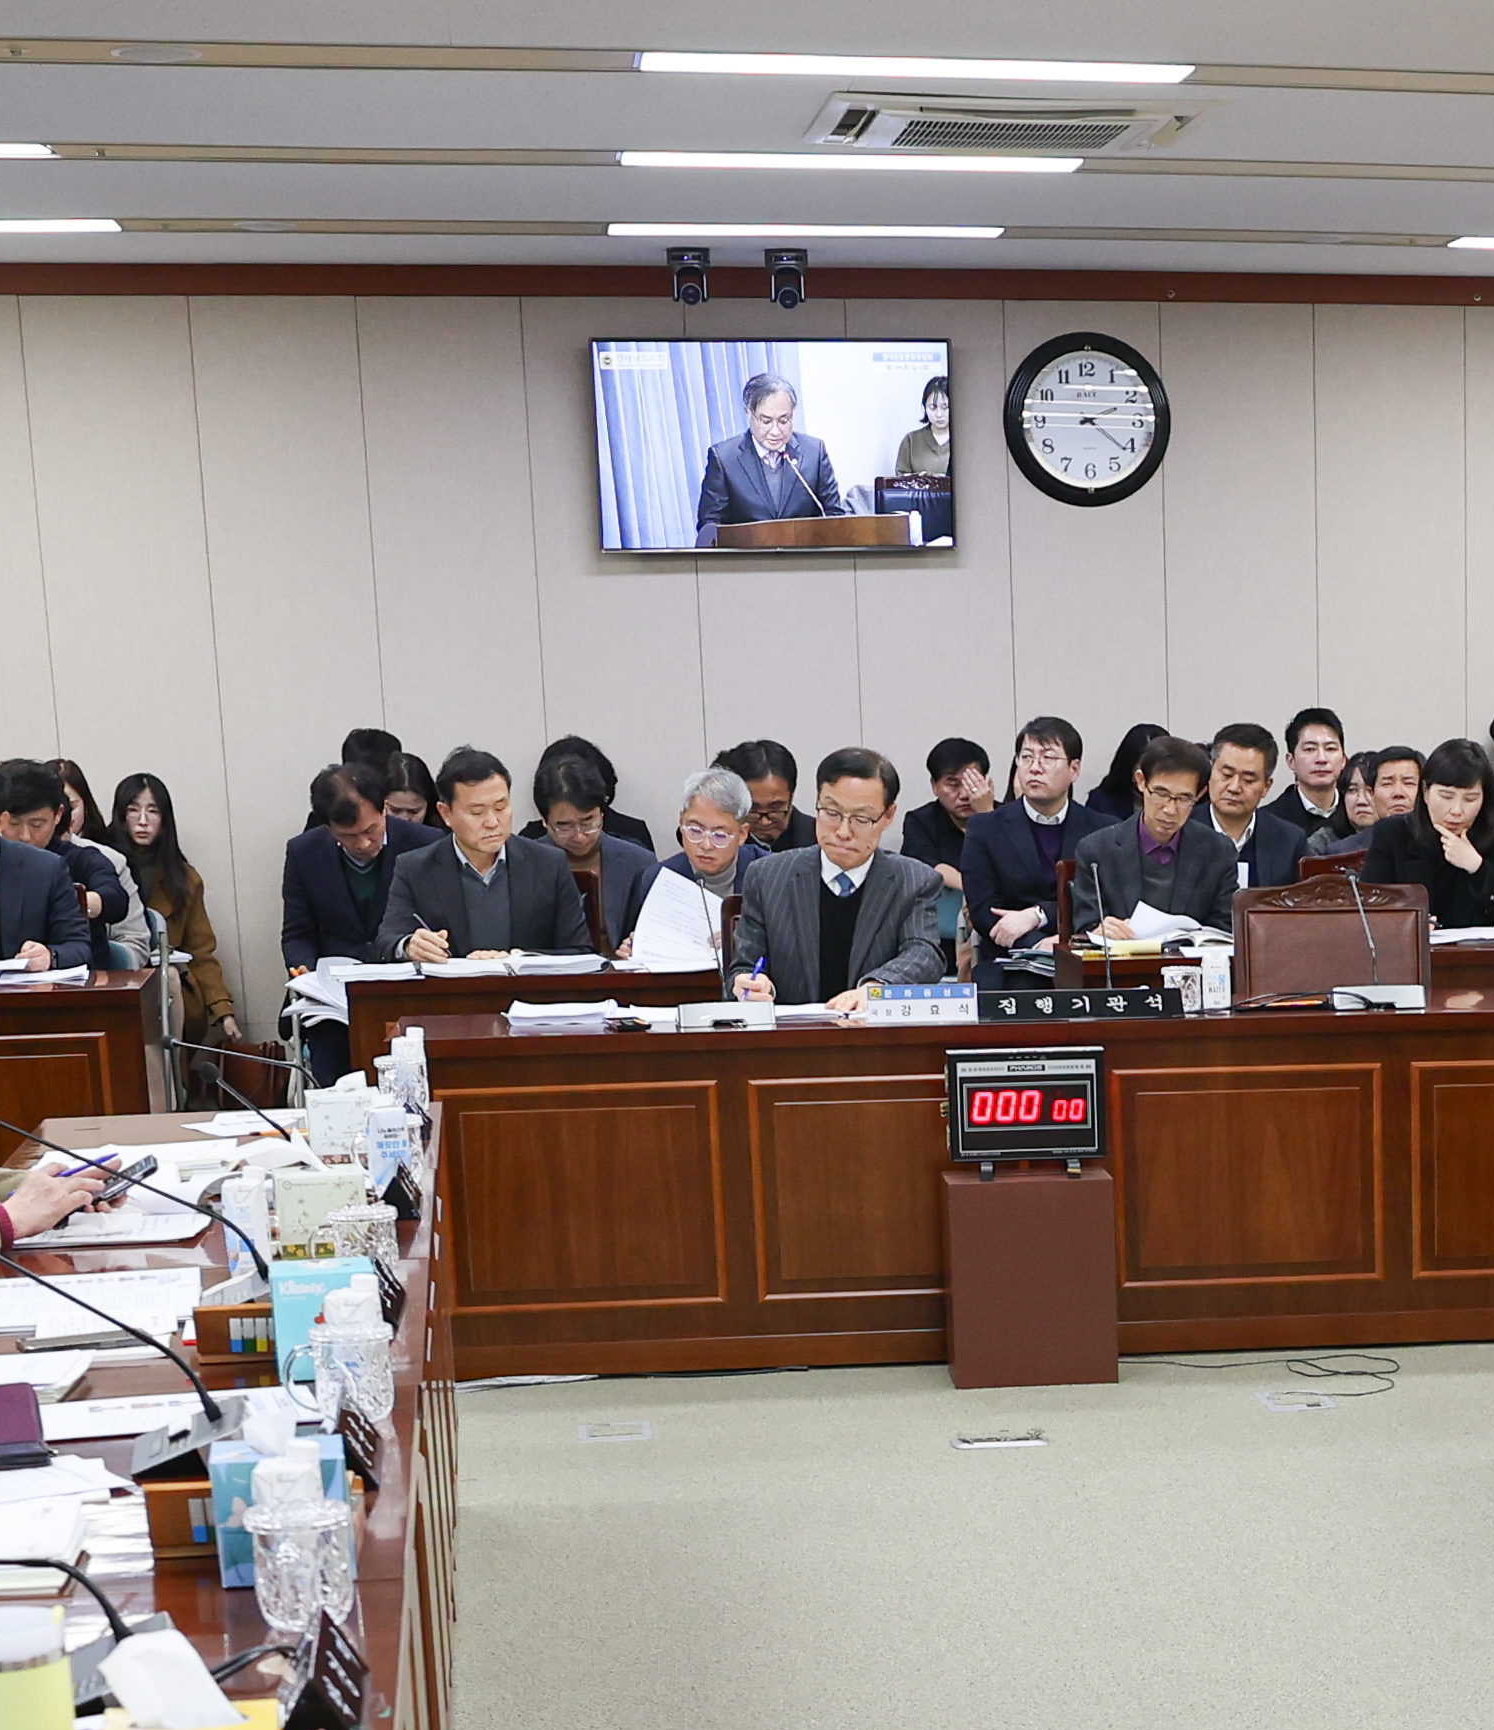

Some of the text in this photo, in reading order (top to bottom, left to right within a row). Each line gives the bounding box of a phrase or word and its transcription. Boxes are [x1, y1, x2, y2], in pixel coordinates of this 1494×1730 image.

[1058, 369, 1070, 384] 11
[1077, 361, 1096, 377] 12
[1109, 369, 1116, 383] 1
[1040, 389, 1054, 404] 10
[1125, 390, 1137, 404] 2
[1034, 415, 1046, 429] 9
[1132, 413, 1144, 429] 3
[1042, 438, 1054, 454] 8
[1124, 437, 1136, 453] 4
[1060, 457, 1072, 472] 7
[1085, 463, 1096, 480] 6
[1109, 456, 1121, 472] 5
[998, 994, 1164, 1016] 집행기관석
[970, 1089, 1087, 1124] 000 00
